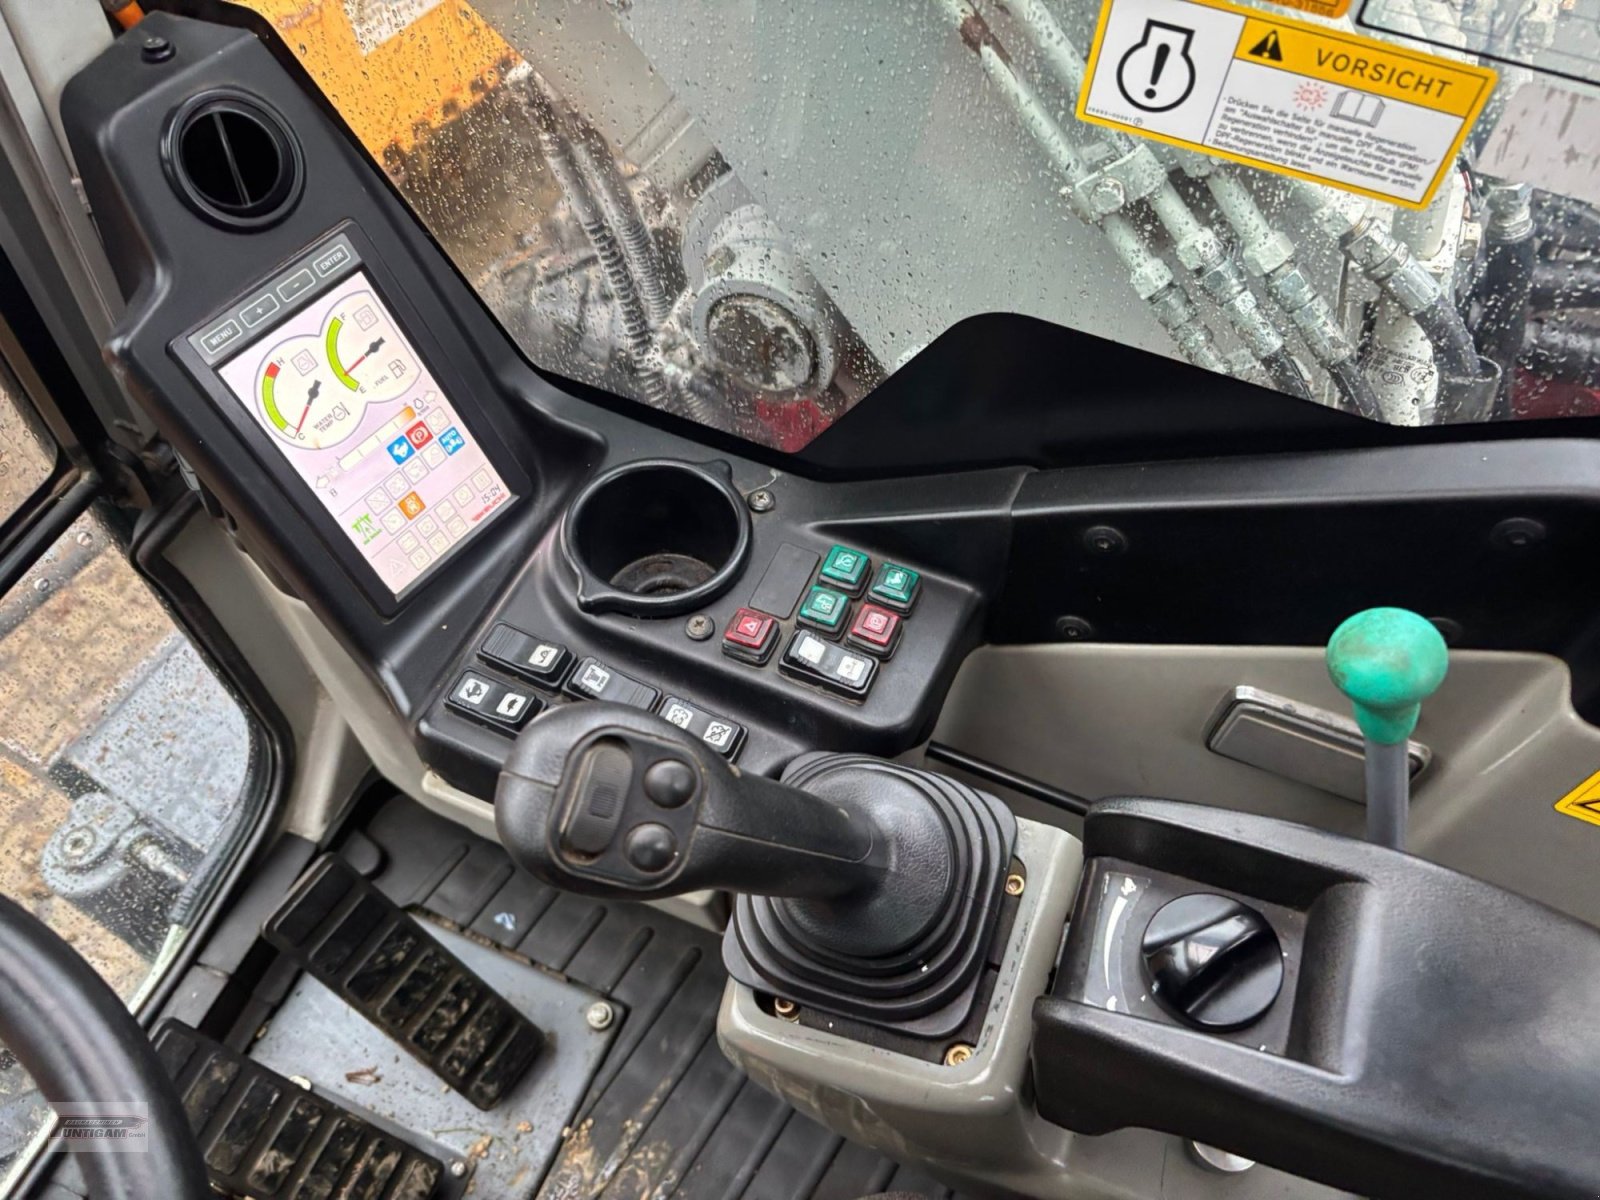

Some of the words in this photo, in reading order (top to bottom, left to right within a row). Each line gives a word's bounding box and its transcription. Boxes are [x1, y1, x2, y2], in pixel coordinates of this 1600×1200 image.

[1316, 48, 1453, 98] VORSICHT
[1227, 95, 1259, 111] Drücken
[1261, 104, 1274, 115] Sie
[1275, 108, 1289, 118] die
[1291, 112, 1312, 124] Seite
[1313, 118, 1325, 128] für
[1326, 122, 1362, 138] manuelle
[1364, 131, 1417, 153] Regeneration
[1214, 129, 1283, 154] DPF-Regeneration
[1284, 148, 1306, 160] blinkt
[1308, 155, 1323, 164] und
[1221, 113, 1270, 133] Regeneration
[1339, 144, 1356, 154] den
[1357, 149, 1396, 165] Feinstaub
[1317, 129, 1353, 145] manuelle
[1355, 138, 1373, 150] DPF
[1276, 137, 1297, 148] wenn
[1299, 142, 1313, 152] die
[1387, 167, 1423, 182] manuelle
[319, 251, 344, 271] ENTER
[208, 326, 234, 346] MENU
[374, 375, 389, 387] FUEL
[313, 413, 333, 430] WATER
[481, 484, 501, 503] 15:04
